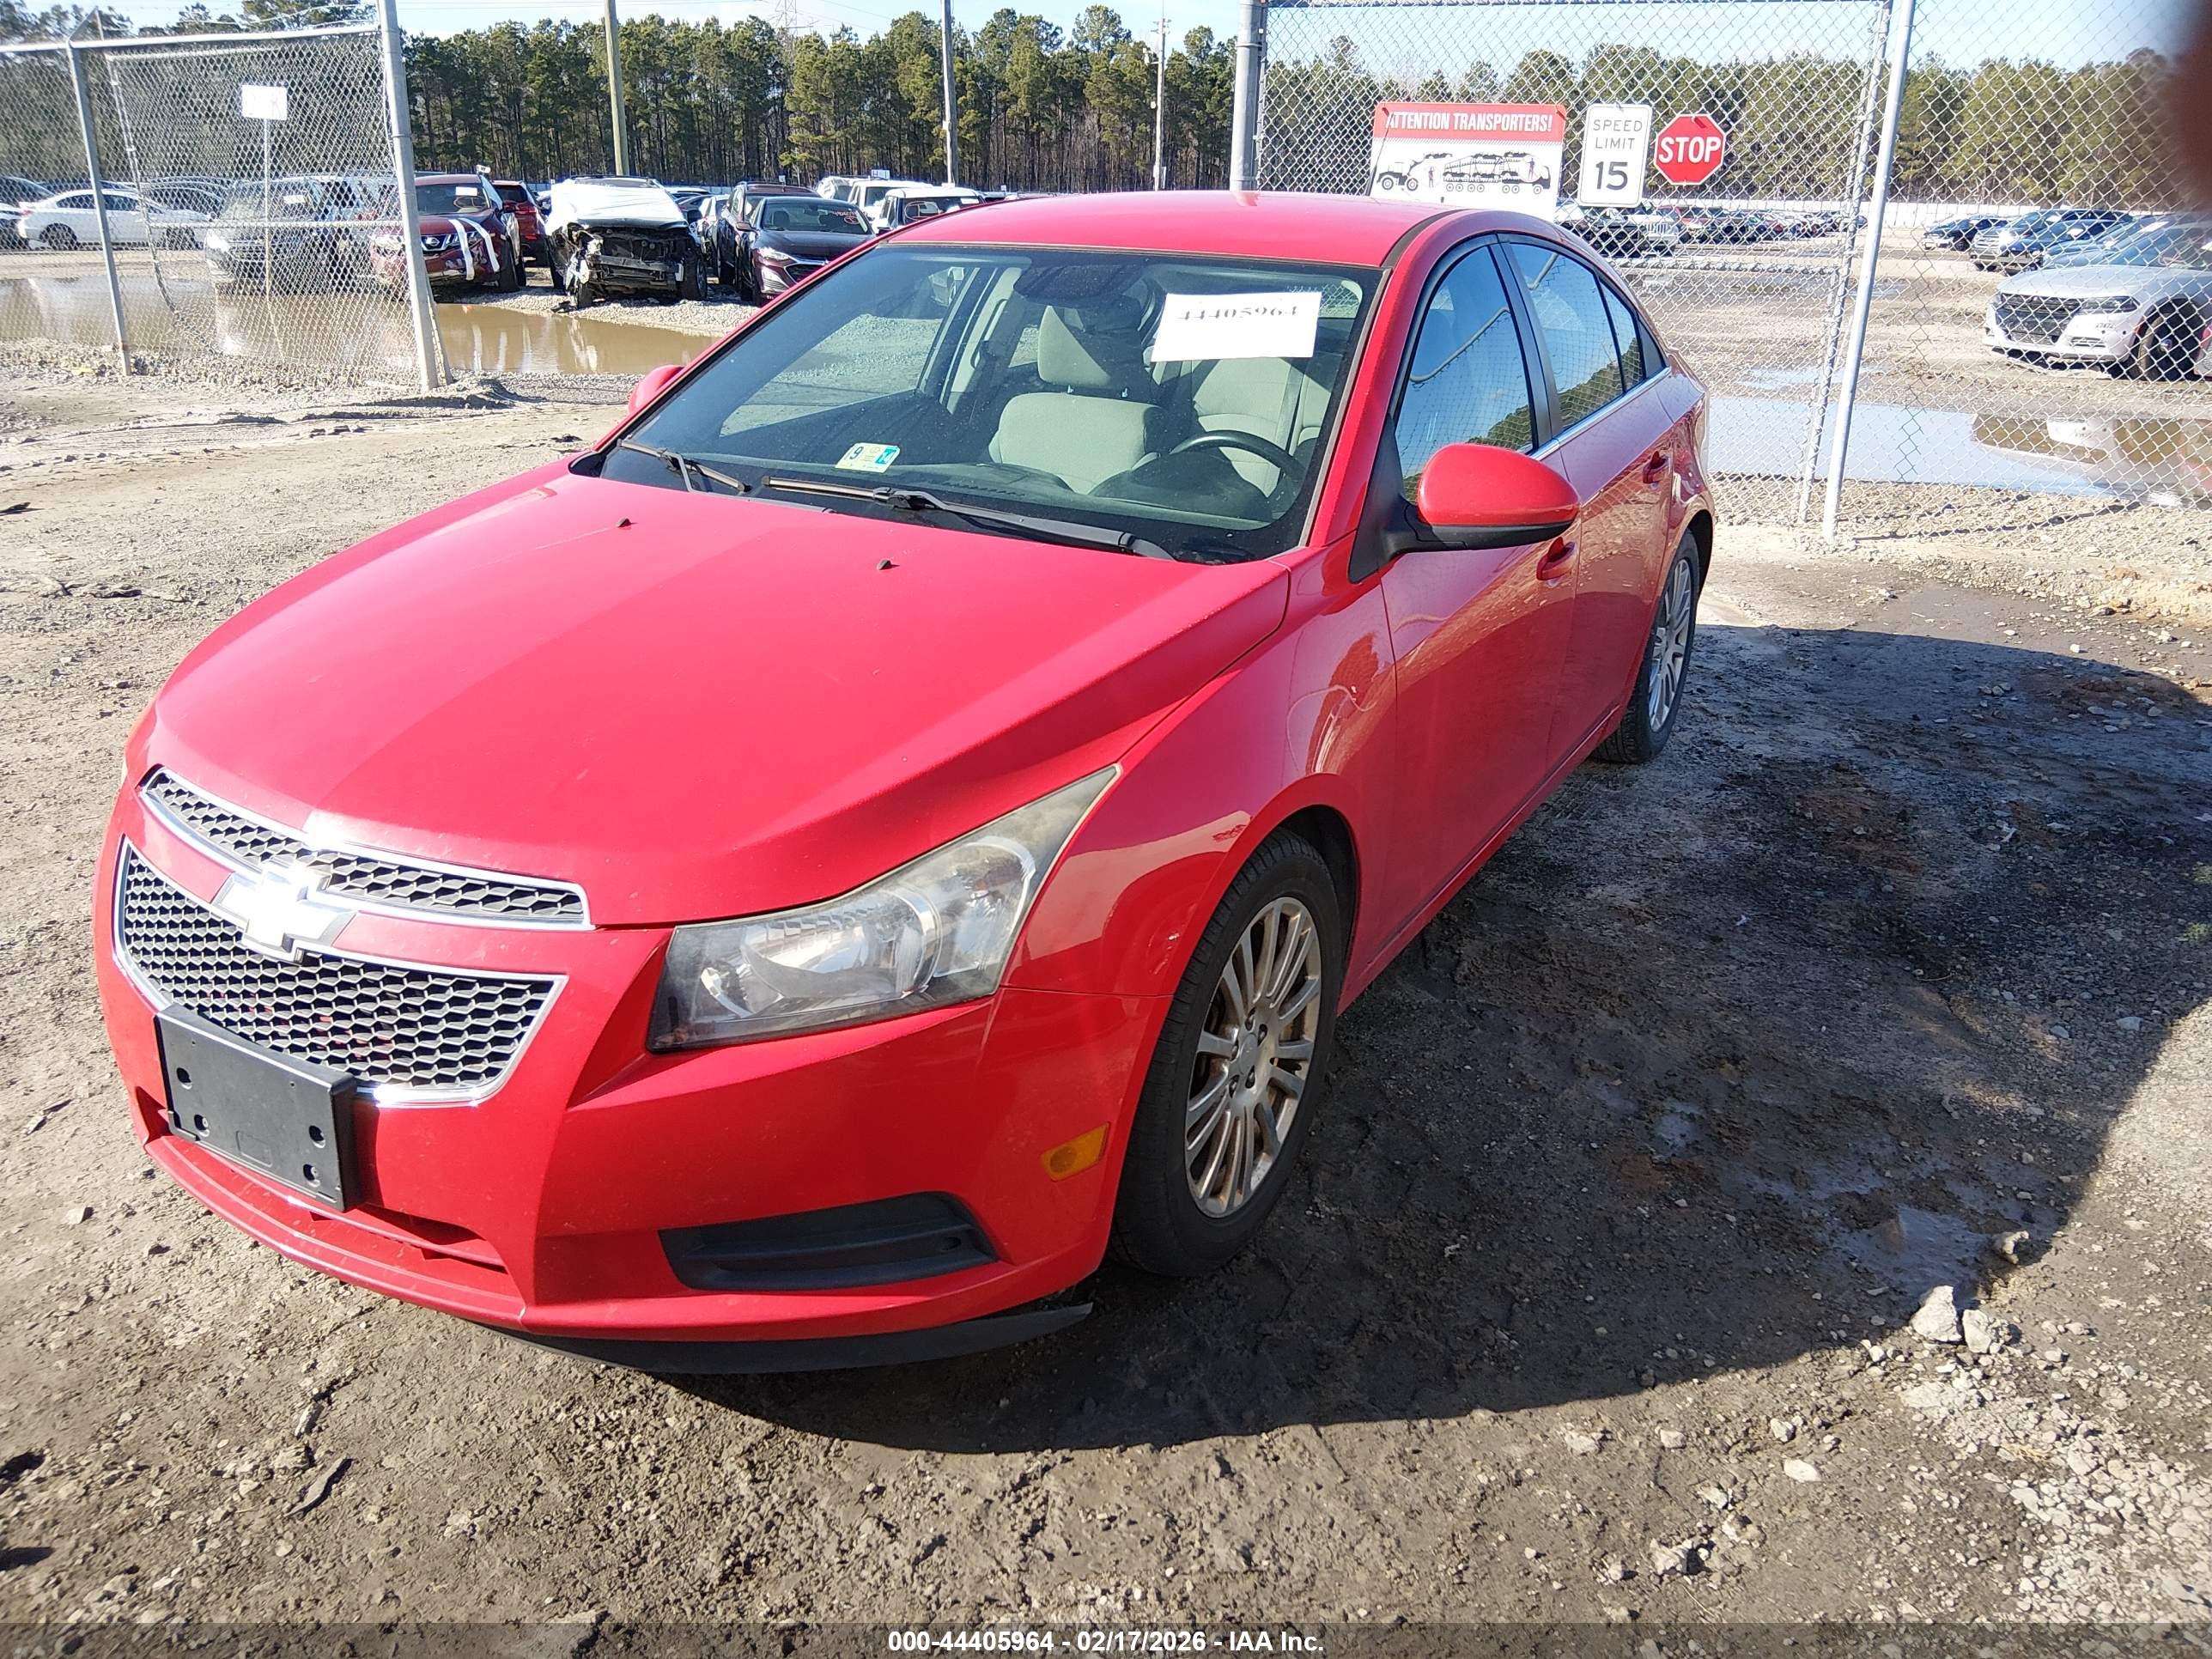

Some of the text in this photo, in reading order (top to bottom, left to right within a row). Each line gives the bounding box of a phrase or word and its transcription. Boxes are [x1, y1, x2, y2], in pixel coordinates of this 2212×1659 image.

[1386, 111, 1553, 132] ATTENTION TRANSPORTERS!
[1593, 119, 1643, 132] SPEED
[1595, 137, 1636, 149] LIMIT
[1658, 137, 1722, 164] STOP
[1595, 161, 1628, 191] 15
